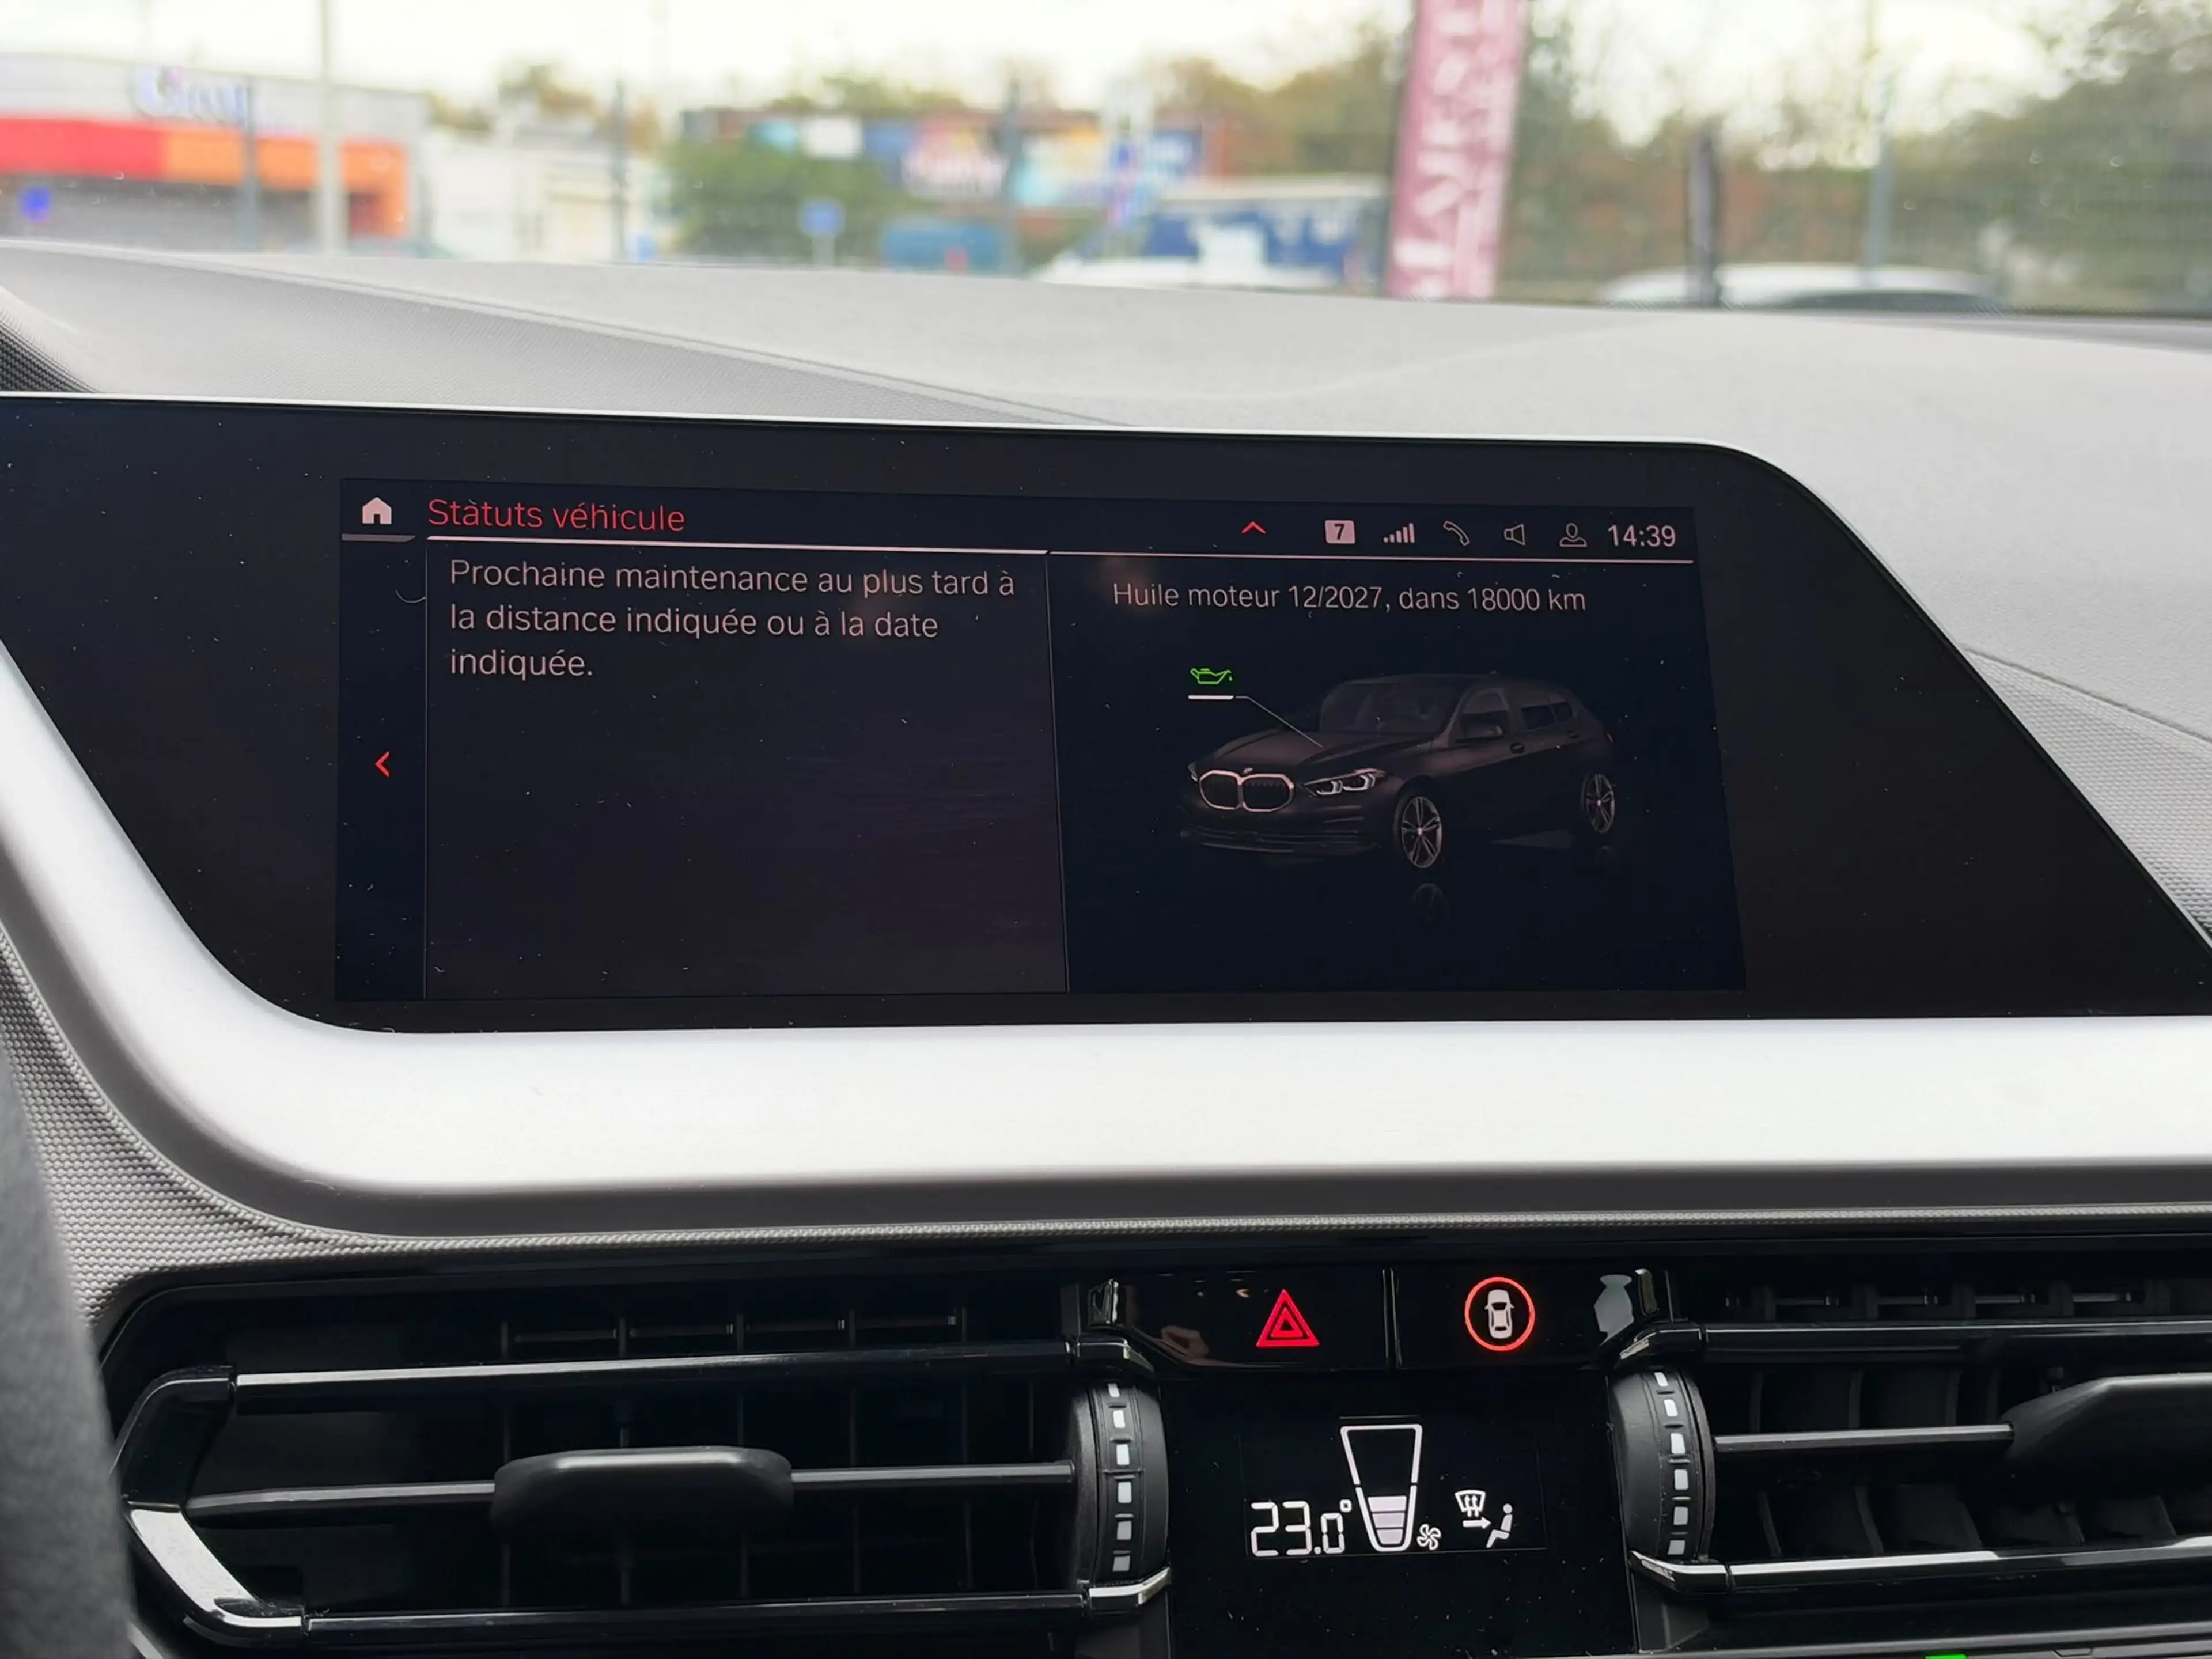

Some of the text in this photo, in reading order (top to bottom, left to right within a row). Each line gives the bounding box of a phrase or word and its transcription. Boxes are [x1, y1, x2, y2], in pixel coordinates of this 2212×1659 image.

[552, 500, 685, 532] véhicule
[1334, 524, 1346, 541] 7
[1608, 524, 1676, 547] 14:39
[450, 559, 1015, 599] Prochaine maintenance au plus tard à
[1113, 582, 1586, 613] Huile moteur 12/2027, dans 18000 km
[450, 603, 939, 639] la distance indiquée ou à la date
[450, 647, 593, 681] indiquée.
